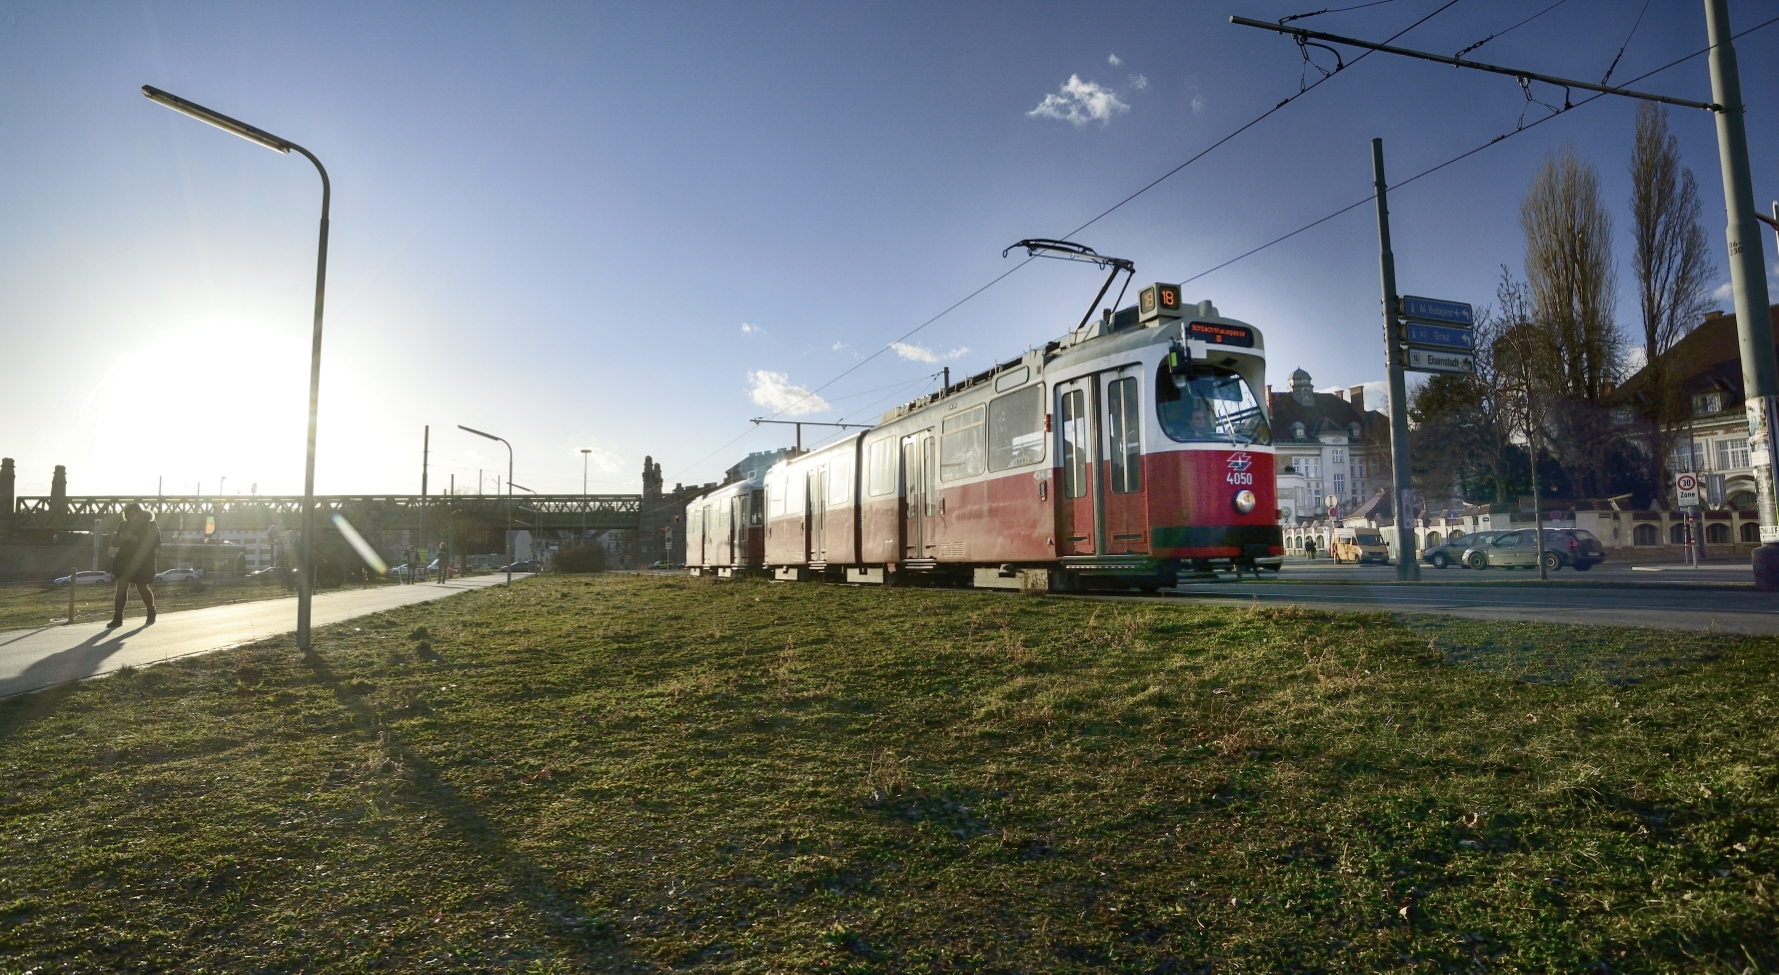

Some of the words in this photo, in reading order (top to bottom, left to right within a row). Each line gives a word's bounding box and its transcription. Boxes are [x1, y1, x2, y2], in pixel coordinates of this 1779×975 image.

[1145, 292, 1154, 308] 18
[1162, 290, 1174, 305] 18
[1428, 305, 1453, 317] Budapest
[1434, 331, 1450, 342] Graz
[1427, 354, 1459, 367] Eisenstadt
[1226, 472, 1253, 485] 4050
[1682, 479, 1691, 487] 30
